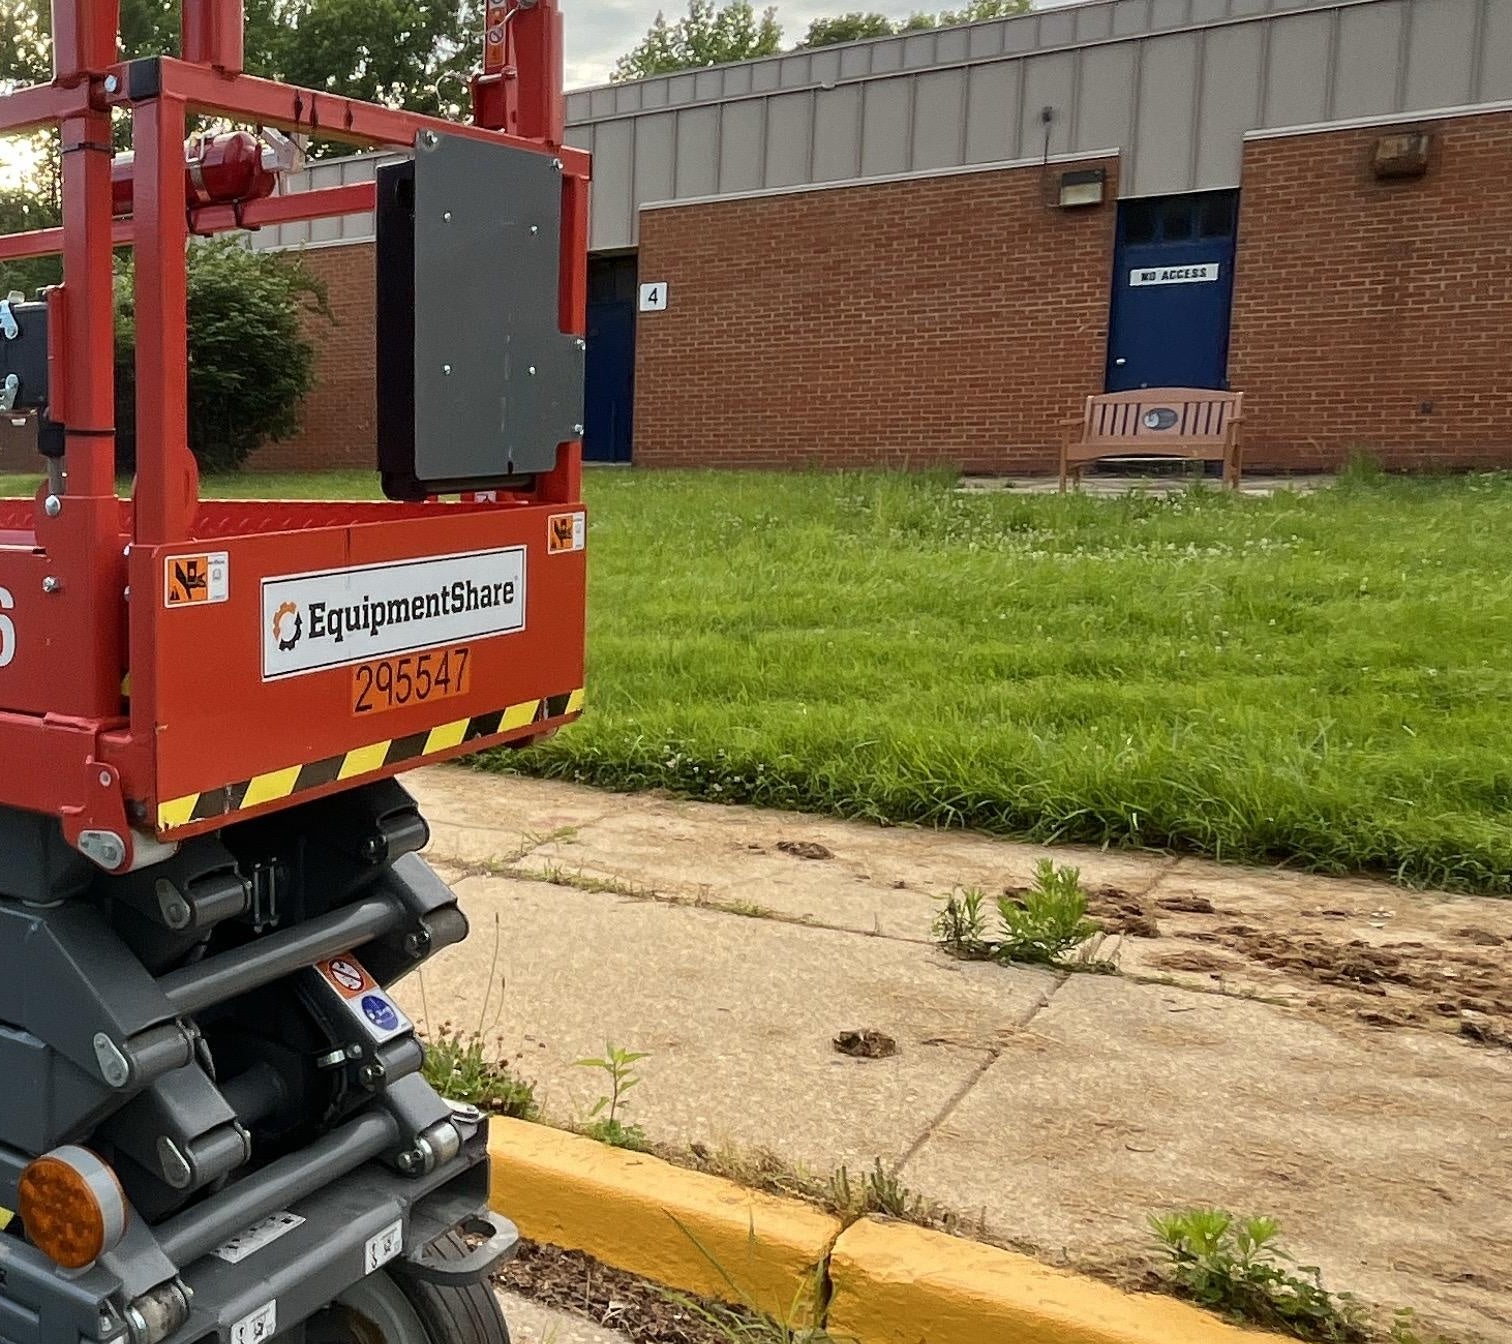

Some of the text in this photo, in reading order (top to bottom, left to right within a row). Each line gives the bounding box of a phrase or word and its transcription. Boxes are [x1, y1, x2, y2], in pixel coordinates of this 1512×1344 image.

[1140, 267, 1208, 282] NO ACCESS
[647, 287, 659, 306] 4
[308, 579, 515, 643] EquipmentShare
[354, 647, 470, 713] 295547
